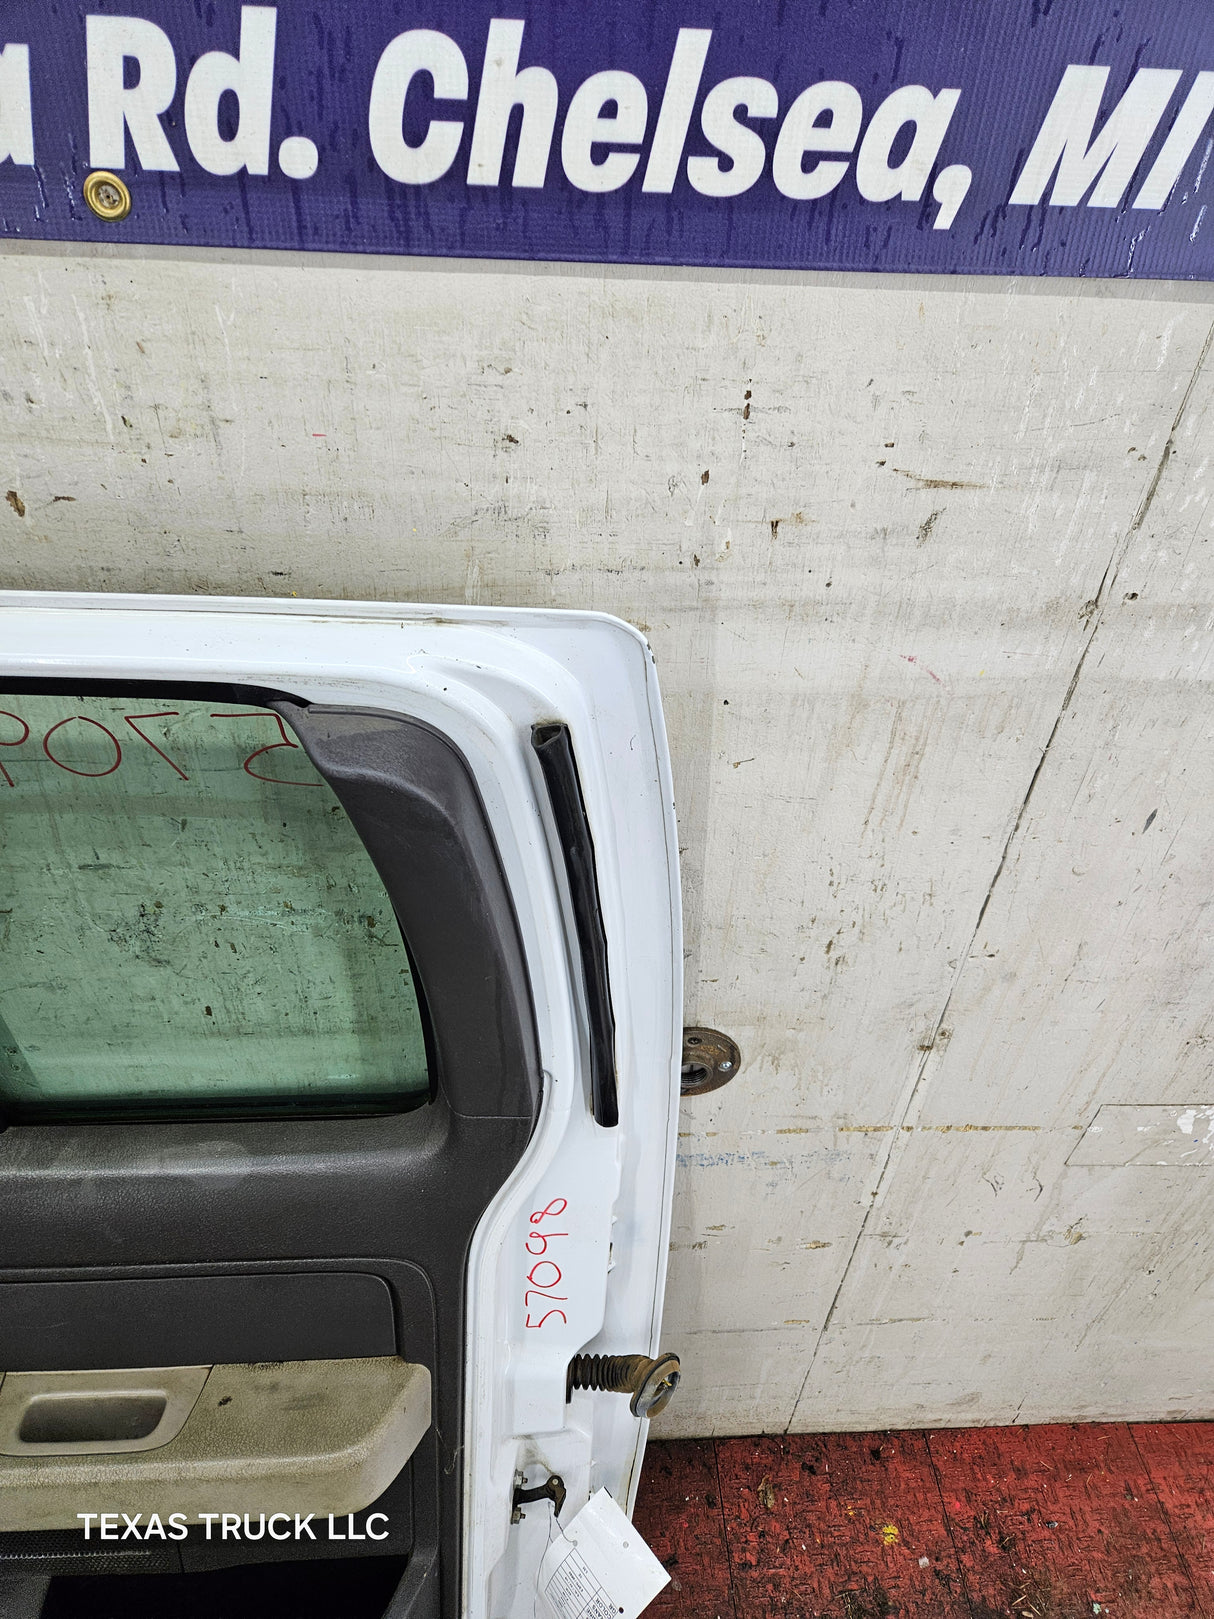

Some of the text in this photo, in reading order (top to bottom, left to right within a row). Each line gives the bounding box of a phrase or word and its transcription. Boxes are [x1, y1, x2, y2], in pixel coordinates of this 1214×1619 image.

[86, 5, 319, 179] Rd.
[368, 18, 973, 230] Chelsea,
[1008, 64, 1214, 210] MI
[525, 1198, 569, 1328] 57098
